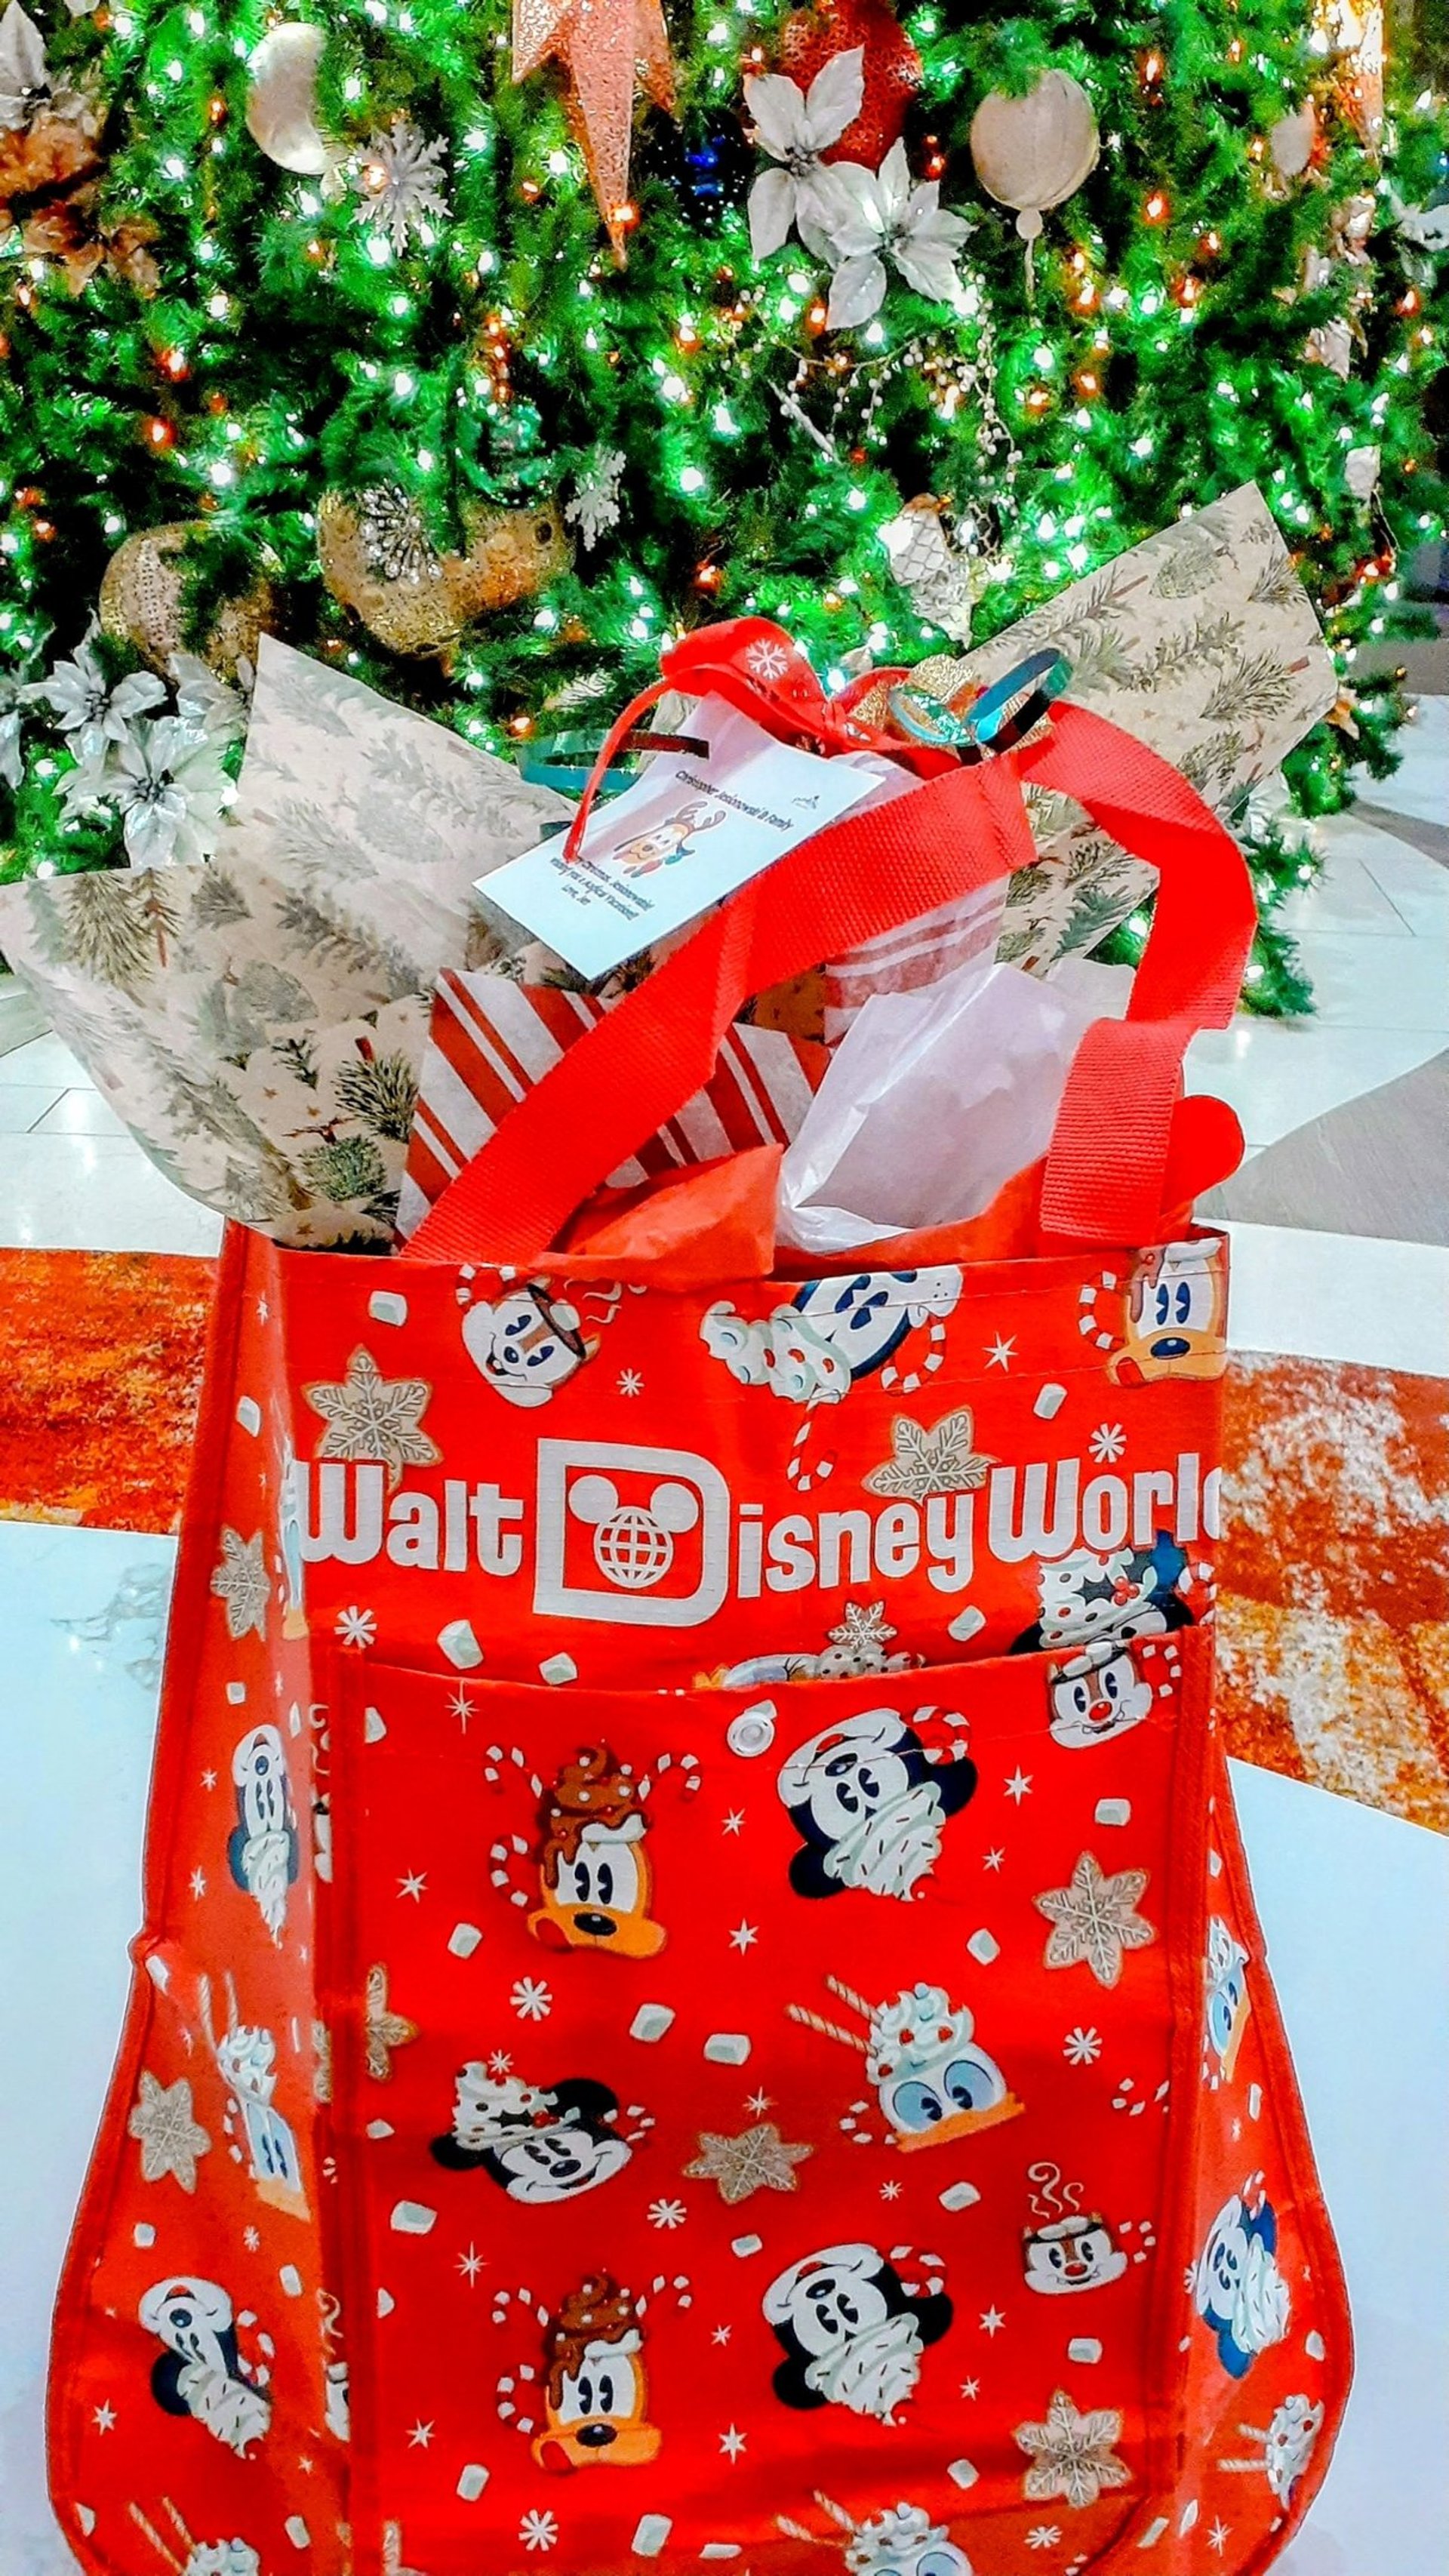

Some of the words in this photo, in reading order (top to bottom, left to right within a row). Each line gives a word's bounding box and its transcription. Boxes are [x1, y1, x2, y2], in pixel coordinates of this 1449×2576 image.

[675, 770, 719, 796] Christopher
[764, 814, 794, 832] Family
[296, 1460, 524, 1577] Walt
[533, 1438, 974, 1627] Disney
